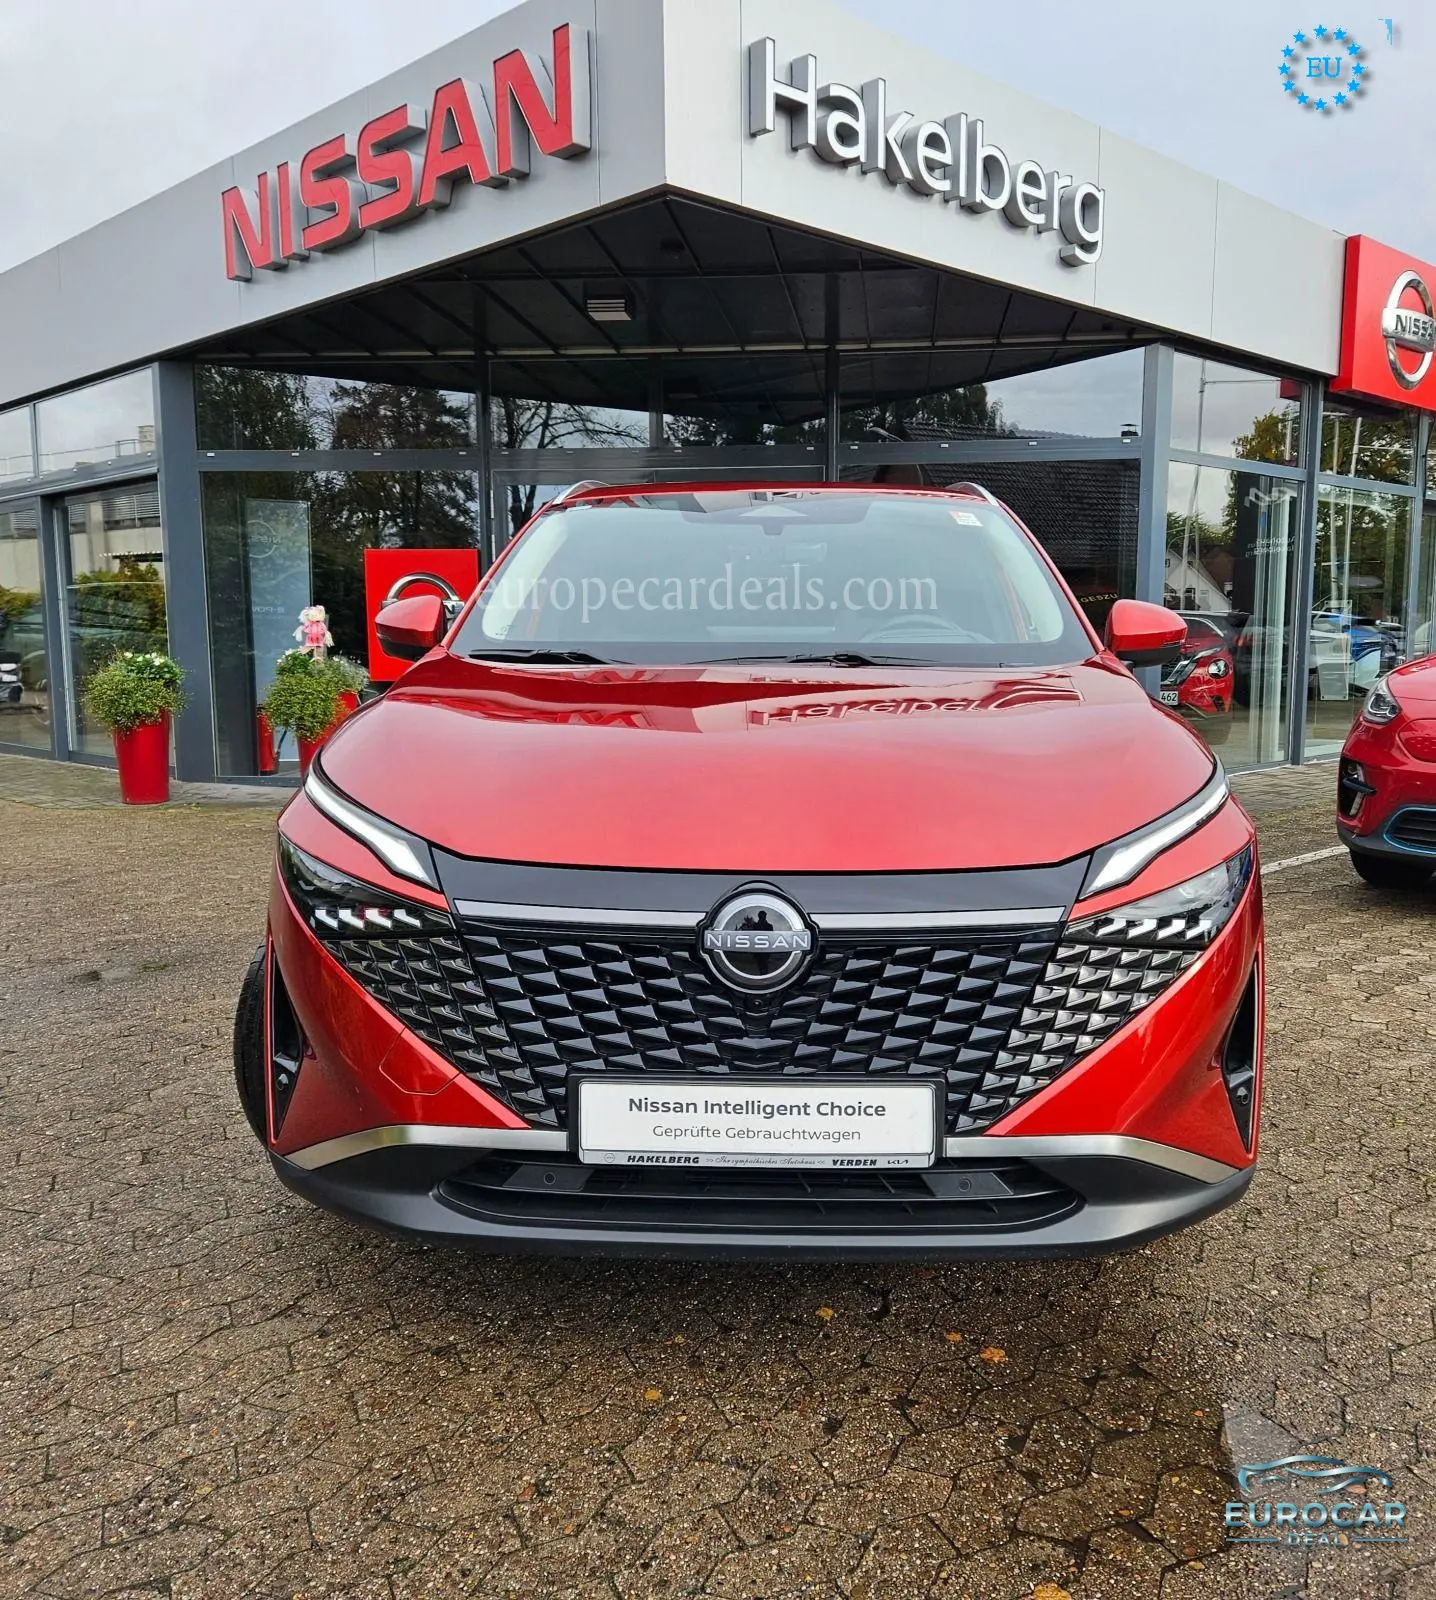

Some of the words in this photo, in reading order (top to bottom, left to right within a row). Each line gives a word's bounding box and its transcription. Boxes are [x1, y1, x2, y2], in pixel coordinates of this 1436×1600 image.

[221, 22, 592, 281] NISSAN
[747, 36, 1106, 267] Hakelberg
[1161, 693, 1177, 702] 462
[707, 933, 809, 949] NISSAN
[628, 1097, 698, 1114] Nissan
[704, 1100, 811, 1119] Intelligent
[816, 1101, 886, 1117] Choice
[652, 1125, 721, 1140] Geprüfte
[725, 1127, 861, 1143] Gebrauchtwagen
[627, 1154, 699, 1165] HAKELBERG
[832, 1158, 878, 1167] VERDEN
